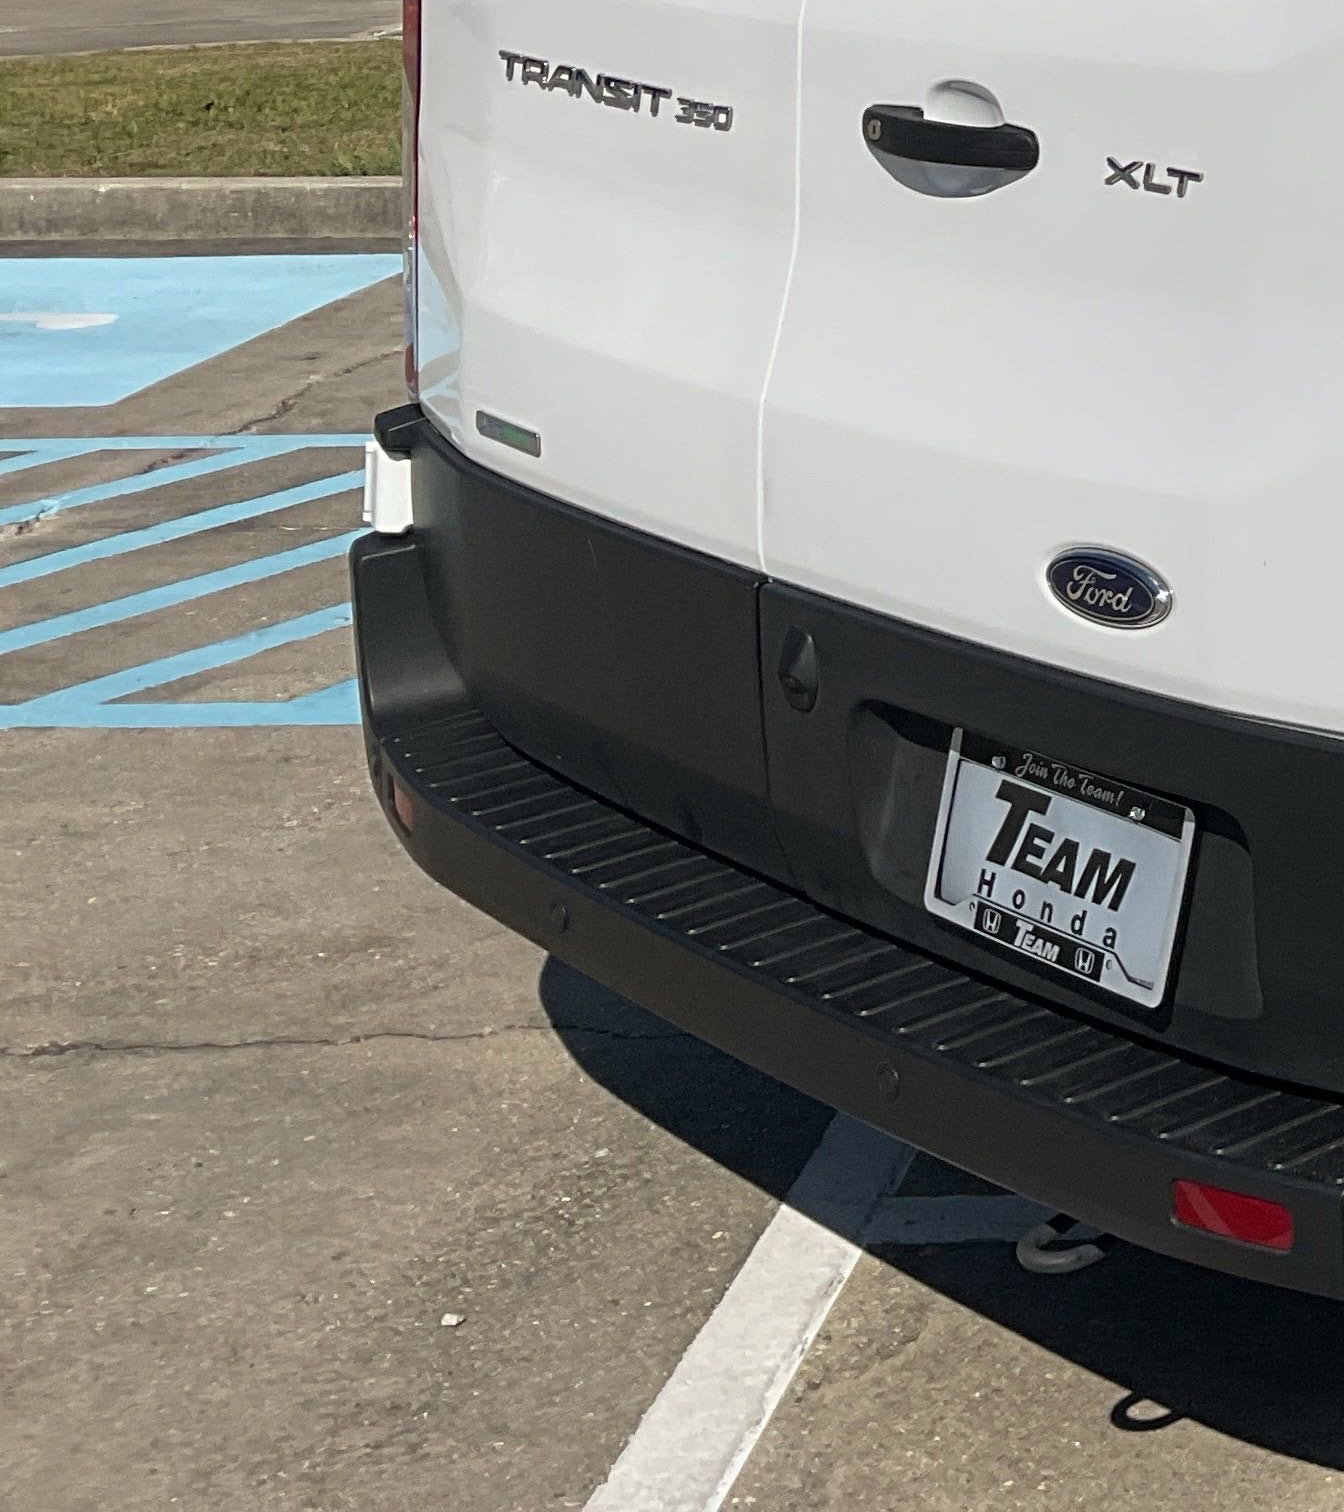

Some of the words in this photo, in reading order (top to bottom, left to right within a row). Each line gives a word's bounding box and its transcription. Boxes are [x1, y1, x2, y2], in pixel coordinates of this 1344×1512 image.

[498, 49, 673, 118] TRANSIT
[674, 97, 734, 131] 350
[1104, 156, 1204, 199] XLT
[1066, 564, 1134, 613] Ford
[1015, 753, 1049, 780] Join
[1051, 762, 1076, 790] The
[1078, 774, 1124, 807] Team!
[986, 779, 1137, 912] TEAM
[976, 868, 1118, 951] Honda
[1013, 921, 1061, 963] TEAM
